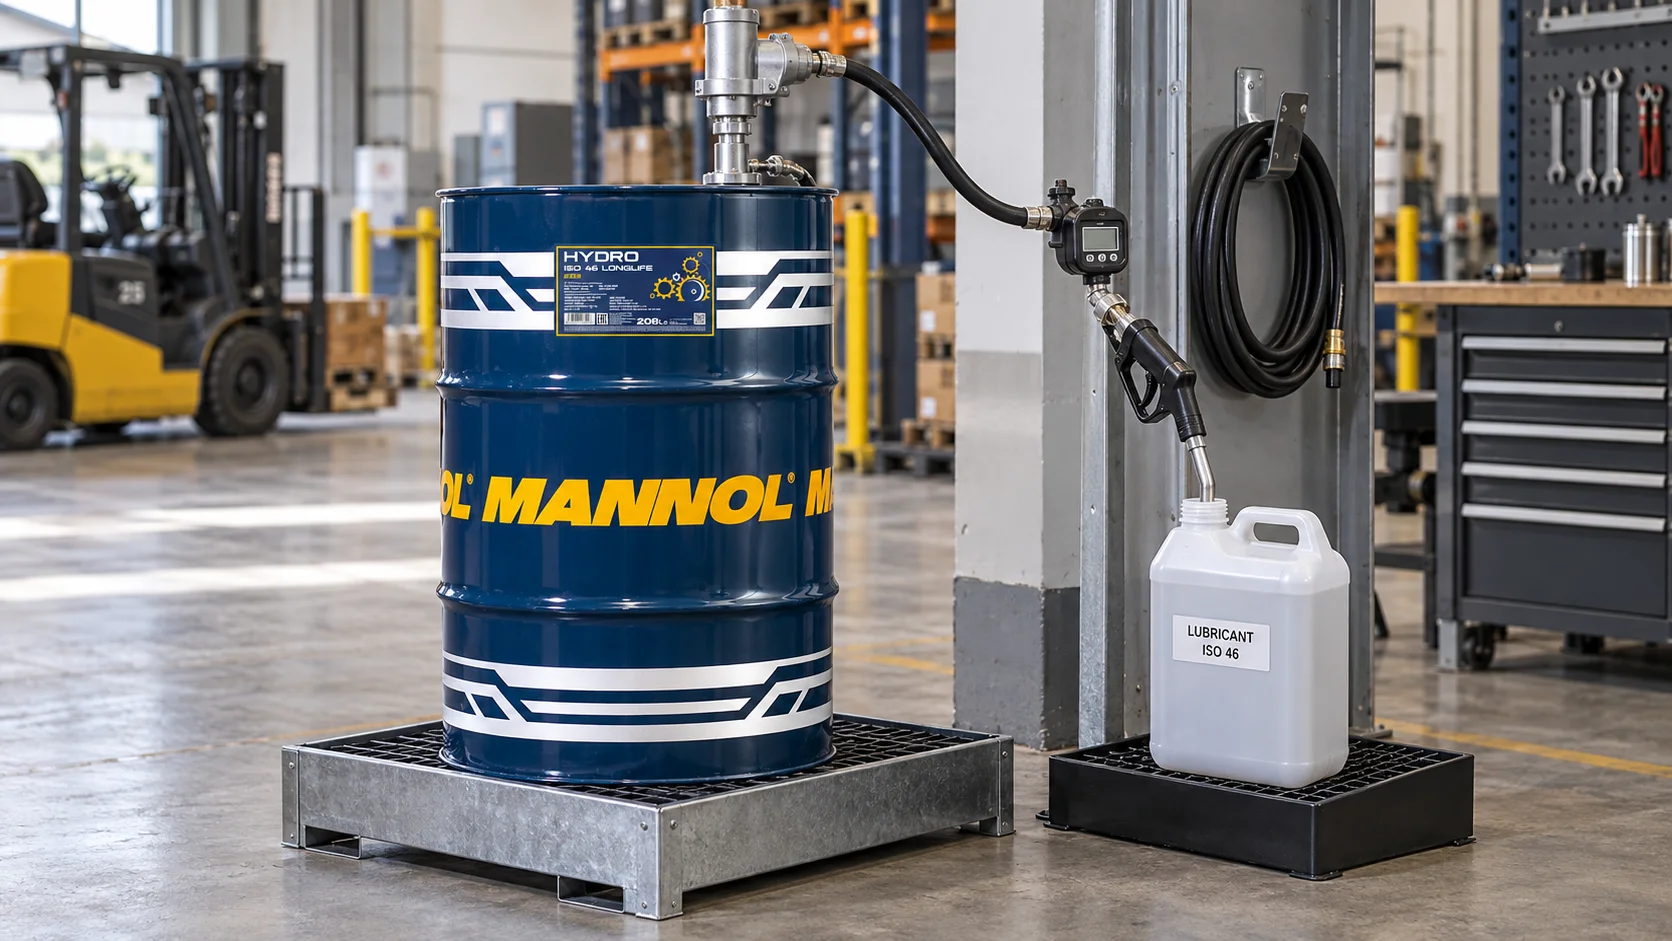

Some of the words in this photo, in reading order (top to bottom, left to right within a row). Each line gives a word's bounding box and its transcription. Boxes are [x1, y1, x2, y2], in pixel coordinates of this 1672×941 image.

[563, 251, 639, 263] HYDRO
[1187, 625, 1254, 643] LUBRICANT
[1202, 644, 1222, 657] ISO
[1225, 647, 1239, 660] 46
